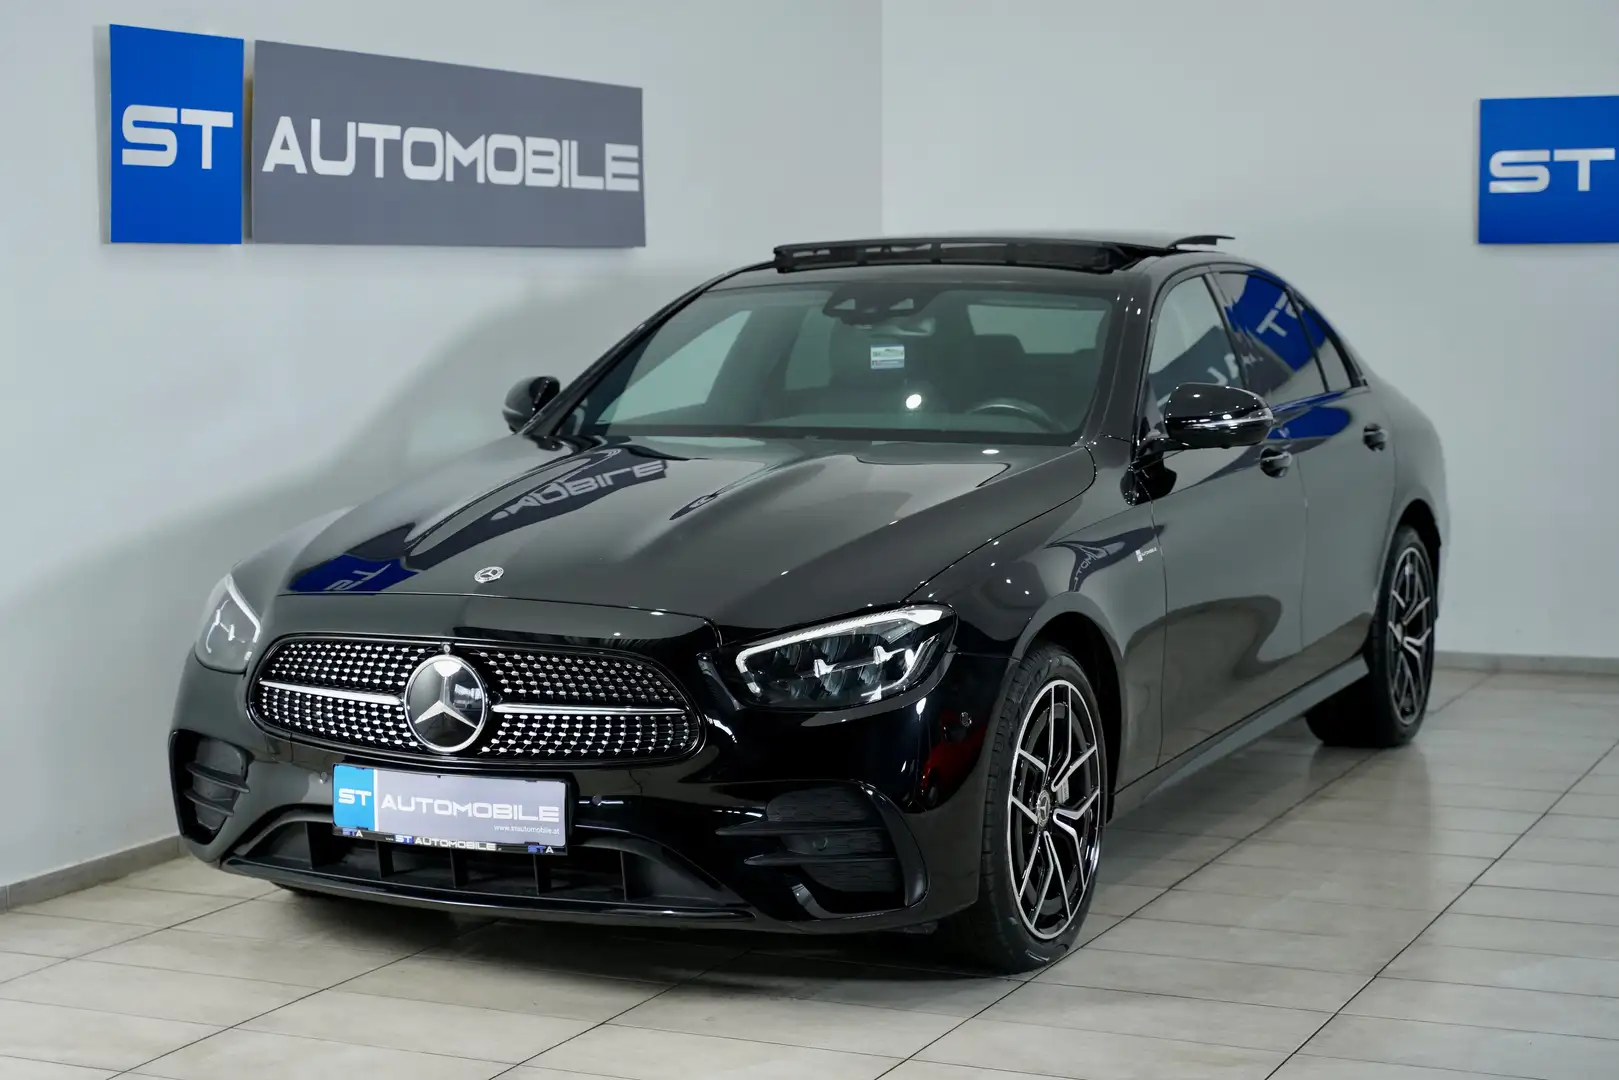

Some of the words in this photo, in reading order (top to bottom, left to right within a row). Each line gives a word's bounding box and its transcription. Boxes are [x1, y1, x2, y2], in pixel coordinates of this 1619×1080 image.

[121, 104, 234, 170] ST
[262, 116, 640, 192] AUTOMOBILE
[1489, 148, 1616, 194] ST
[338, 788, 372, 806] ST
[381, 794, 560, 823] AUTOMOBILE
[394, 834, 413, 844] ST
[414, 836, 497, 851] AUTOMOBILE
